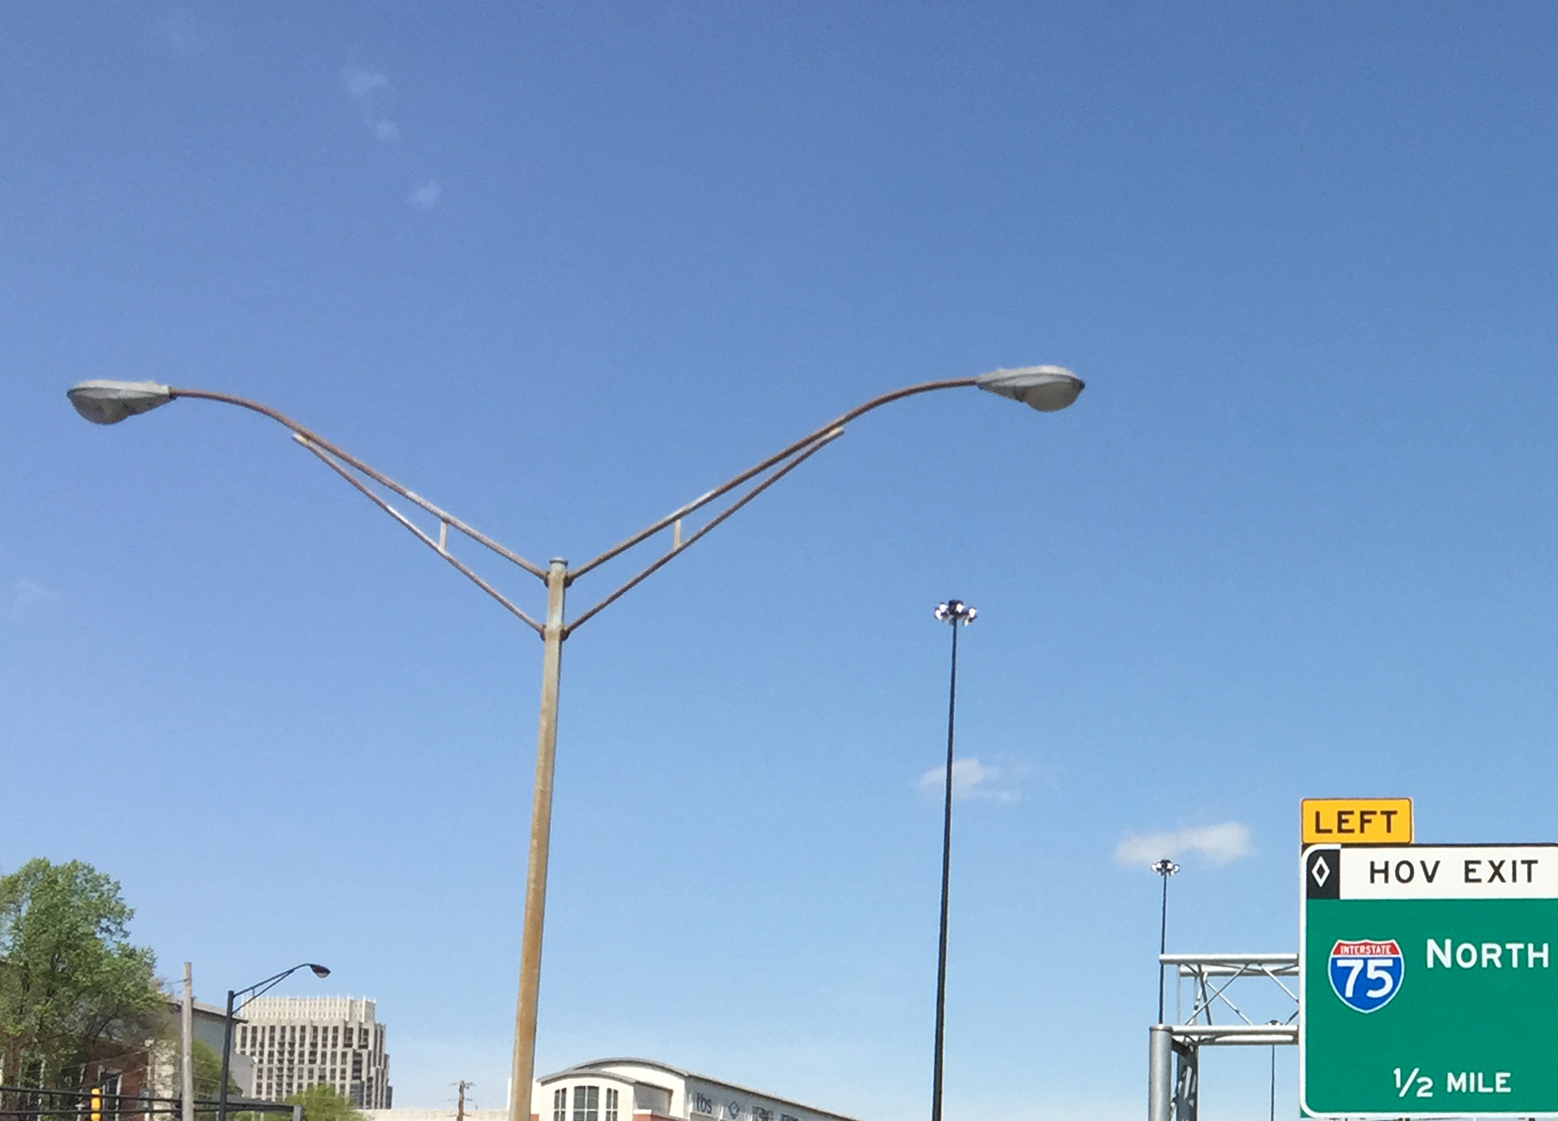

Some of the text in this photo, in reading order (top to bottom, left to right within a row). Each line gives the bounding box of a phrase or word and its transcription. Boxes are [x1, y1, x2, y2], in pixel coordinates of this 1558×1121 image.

[1314, 810, 1398, 834] LEFT
[1369, 859, 1539, 884] HOV EXIT
[1340, 944, 1391, 955] INTERSTATE
[1426, 938, 1549, 969] NORTH
[1337, 957, 1392, 998] 75
[1446, 1072, 1512, 1093] MILE
[696, 1093, 713, 1114] tbs
